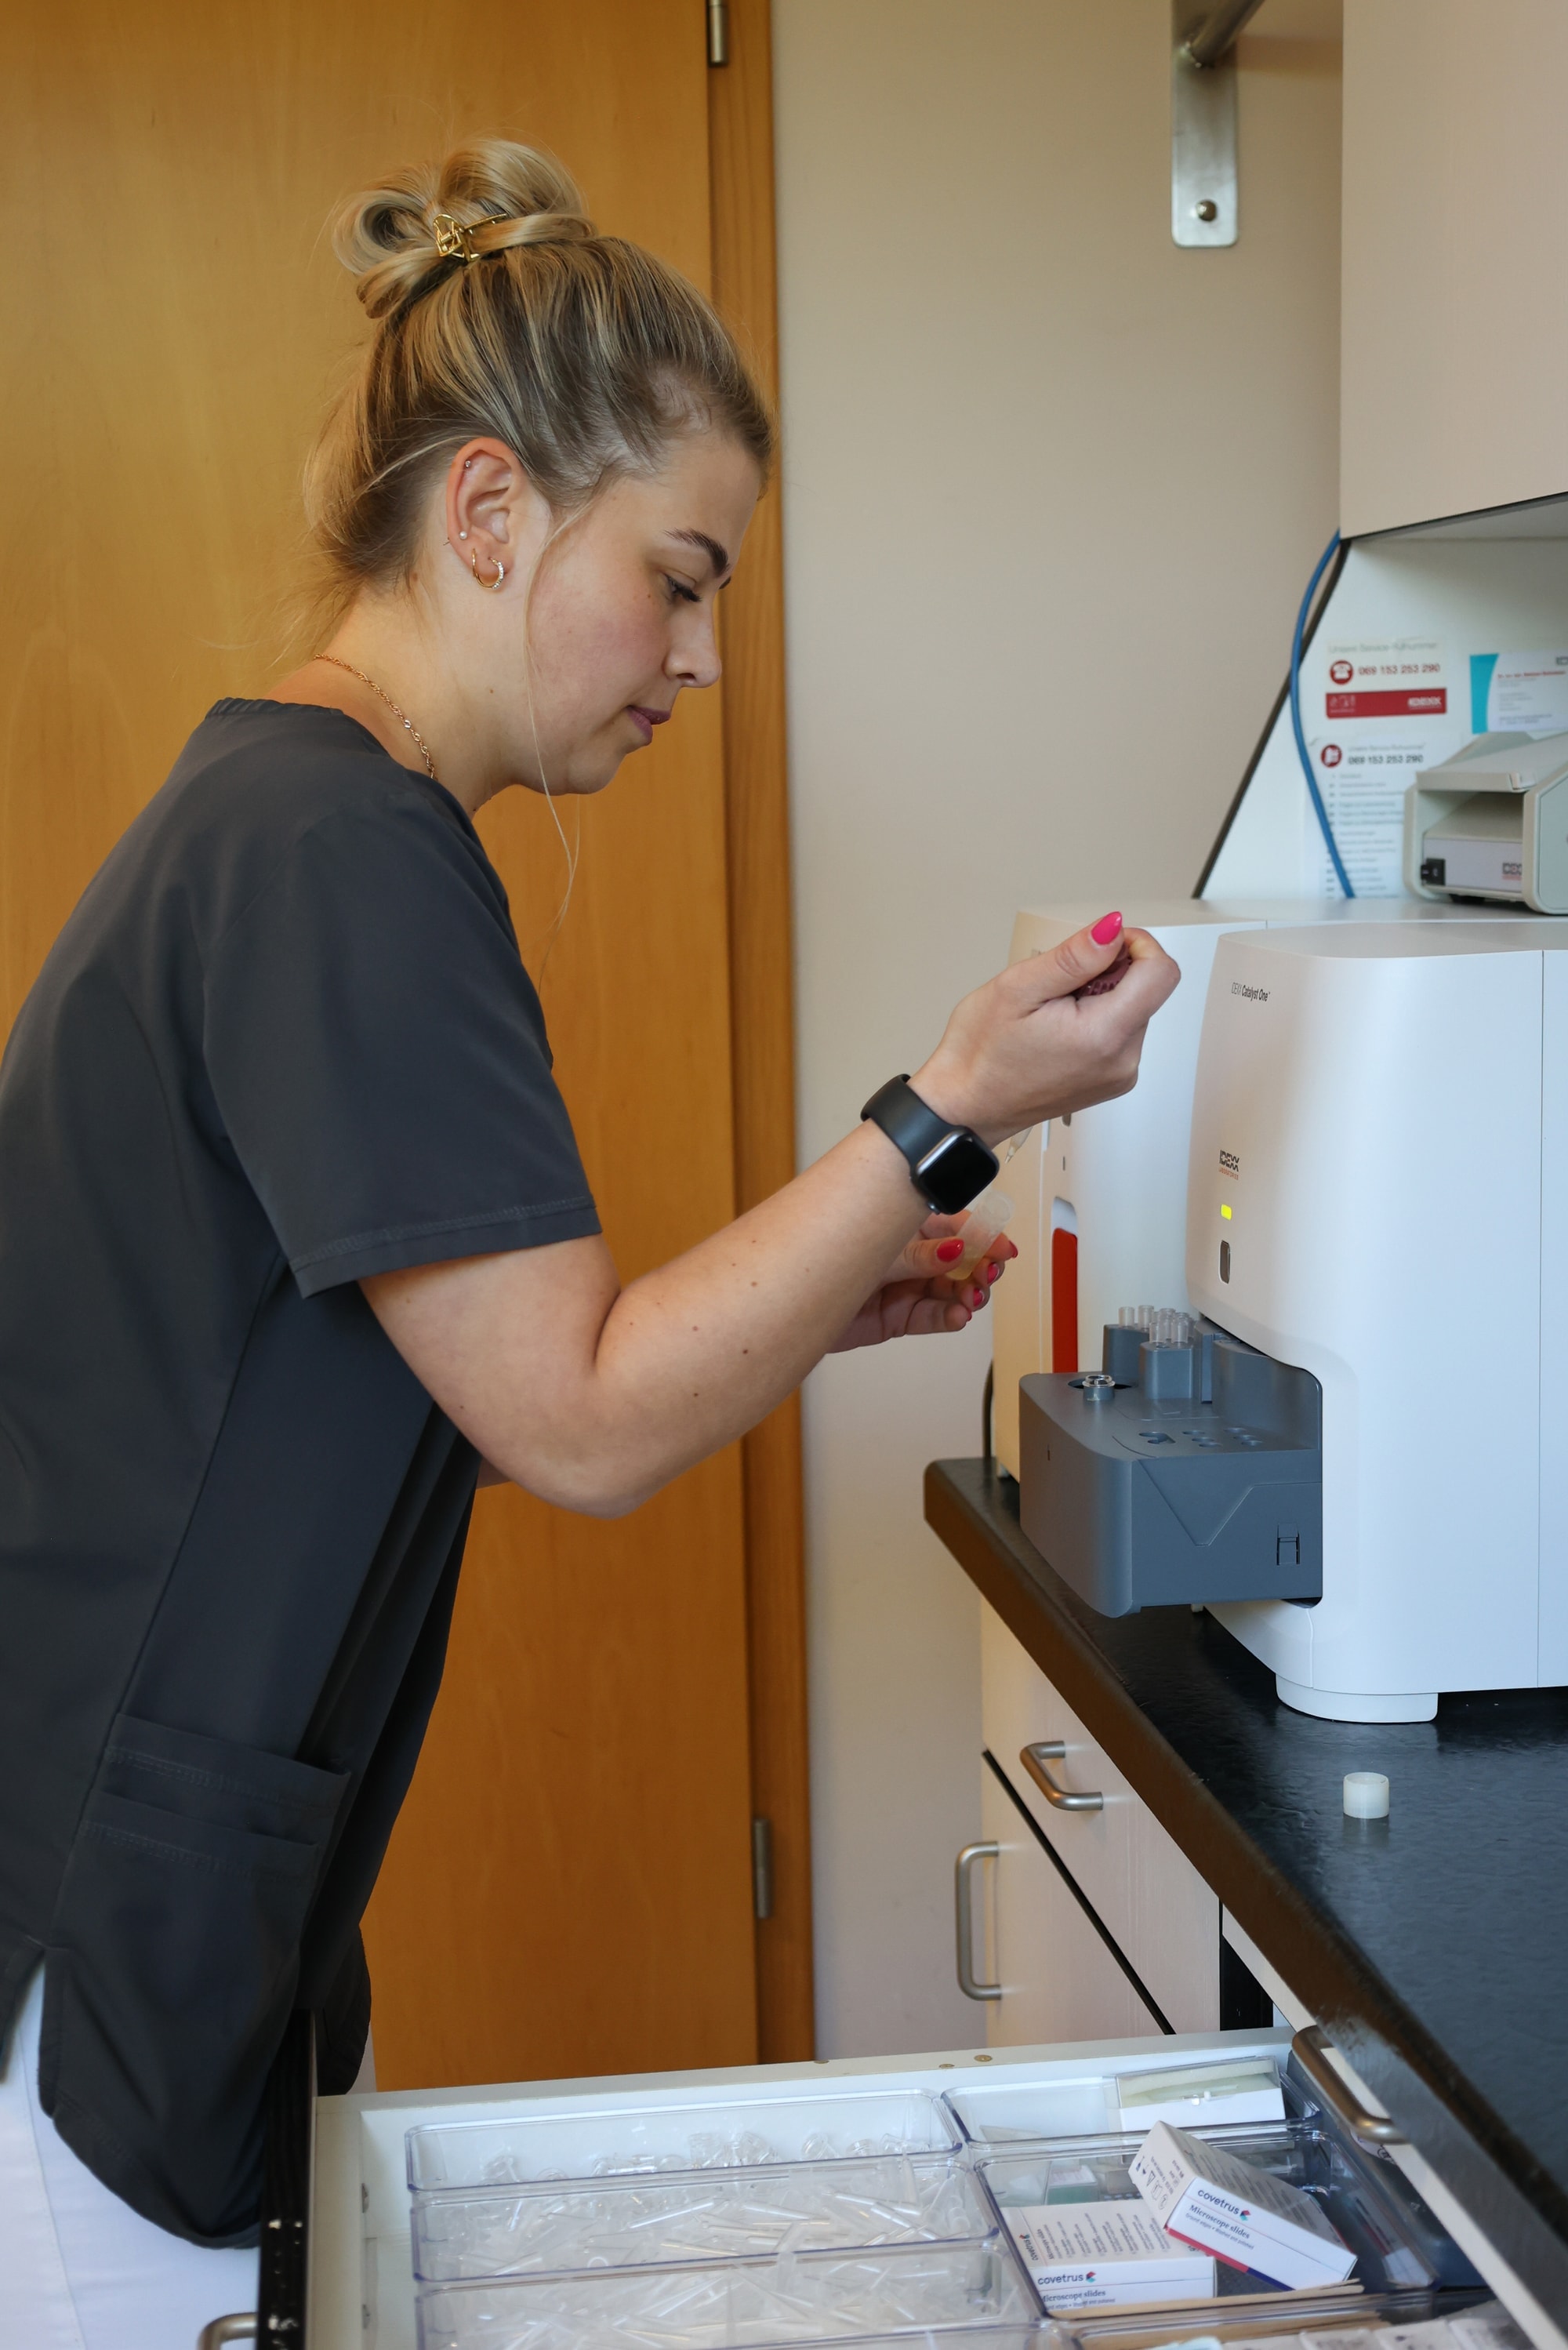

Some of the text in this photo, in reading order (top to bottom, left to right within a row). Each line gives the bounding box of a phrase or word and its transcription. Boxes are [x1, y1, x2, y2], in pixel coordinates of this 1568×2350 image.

[1380, 665, 1398, 674] 153
[1401, 663, 1419, 674] 253
[1421, 663, 1441, 673] 290
[1368, 755, 1384, 765] 153
[1386, 754, 1403, 765] 253
[1406, 754, 1424, 764] 290
[1241, 984, 1259, 1002] Catalyst
[1220, 1150, 1239, 1171] IDEXX
[1197, 2189, 1240, 2215] covetrus
[1189, 2204, 1250, 2239] Microscope slides
[1037, 2273, 1084, 2285] covetrus
